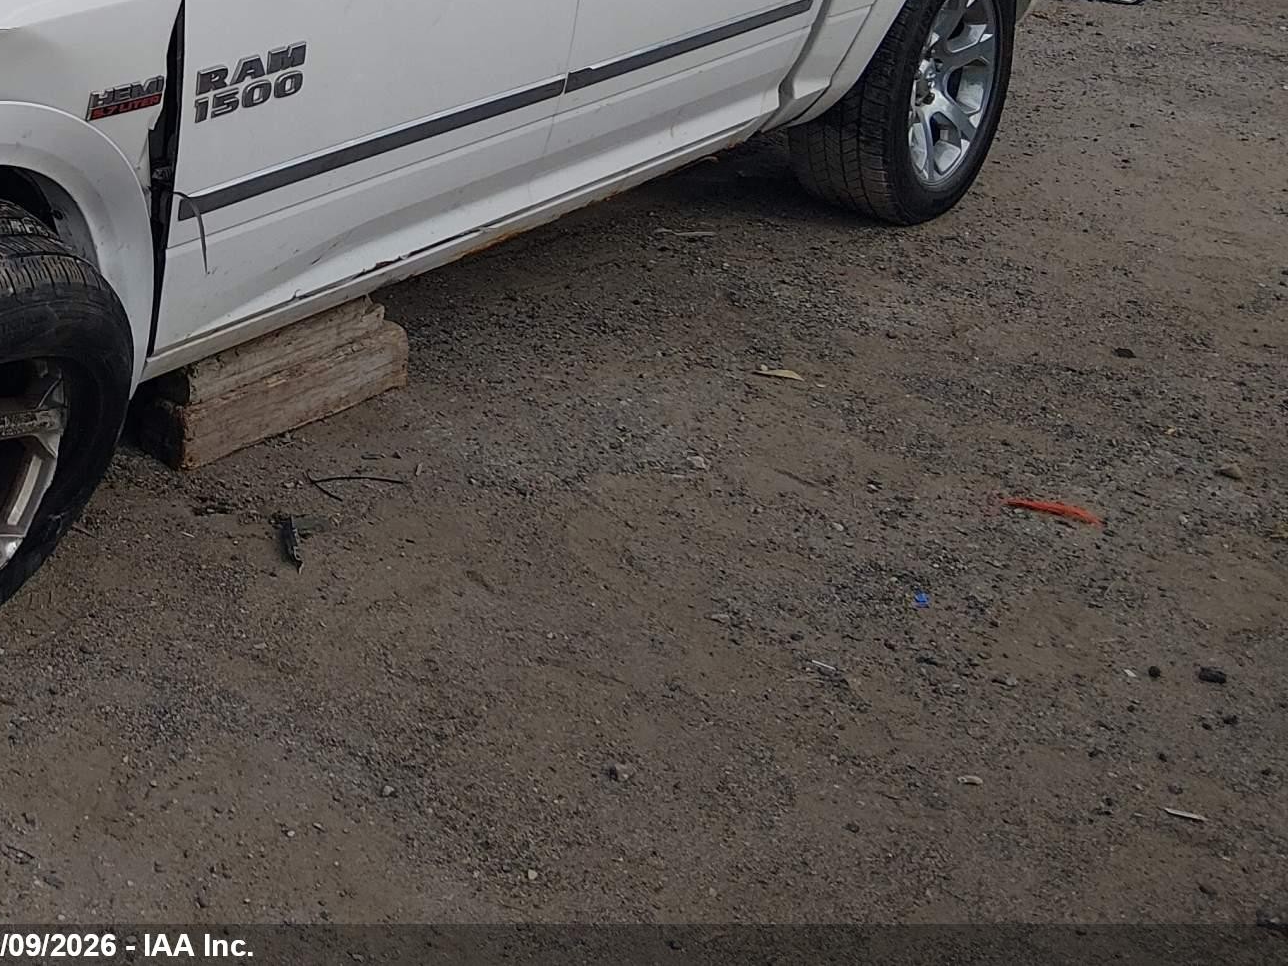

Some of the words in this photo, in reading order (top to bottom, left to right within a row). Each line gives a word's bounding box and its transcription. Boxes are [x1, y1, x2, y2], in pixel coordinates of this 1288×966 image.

[196, 40, 307, 96] RAM
[89, 75, 165, 109] HEMI
[91, 105, 117, 119] 5.7
[119, 95, 161, 113] LITER
[194, 69, 304, 124] 1500
